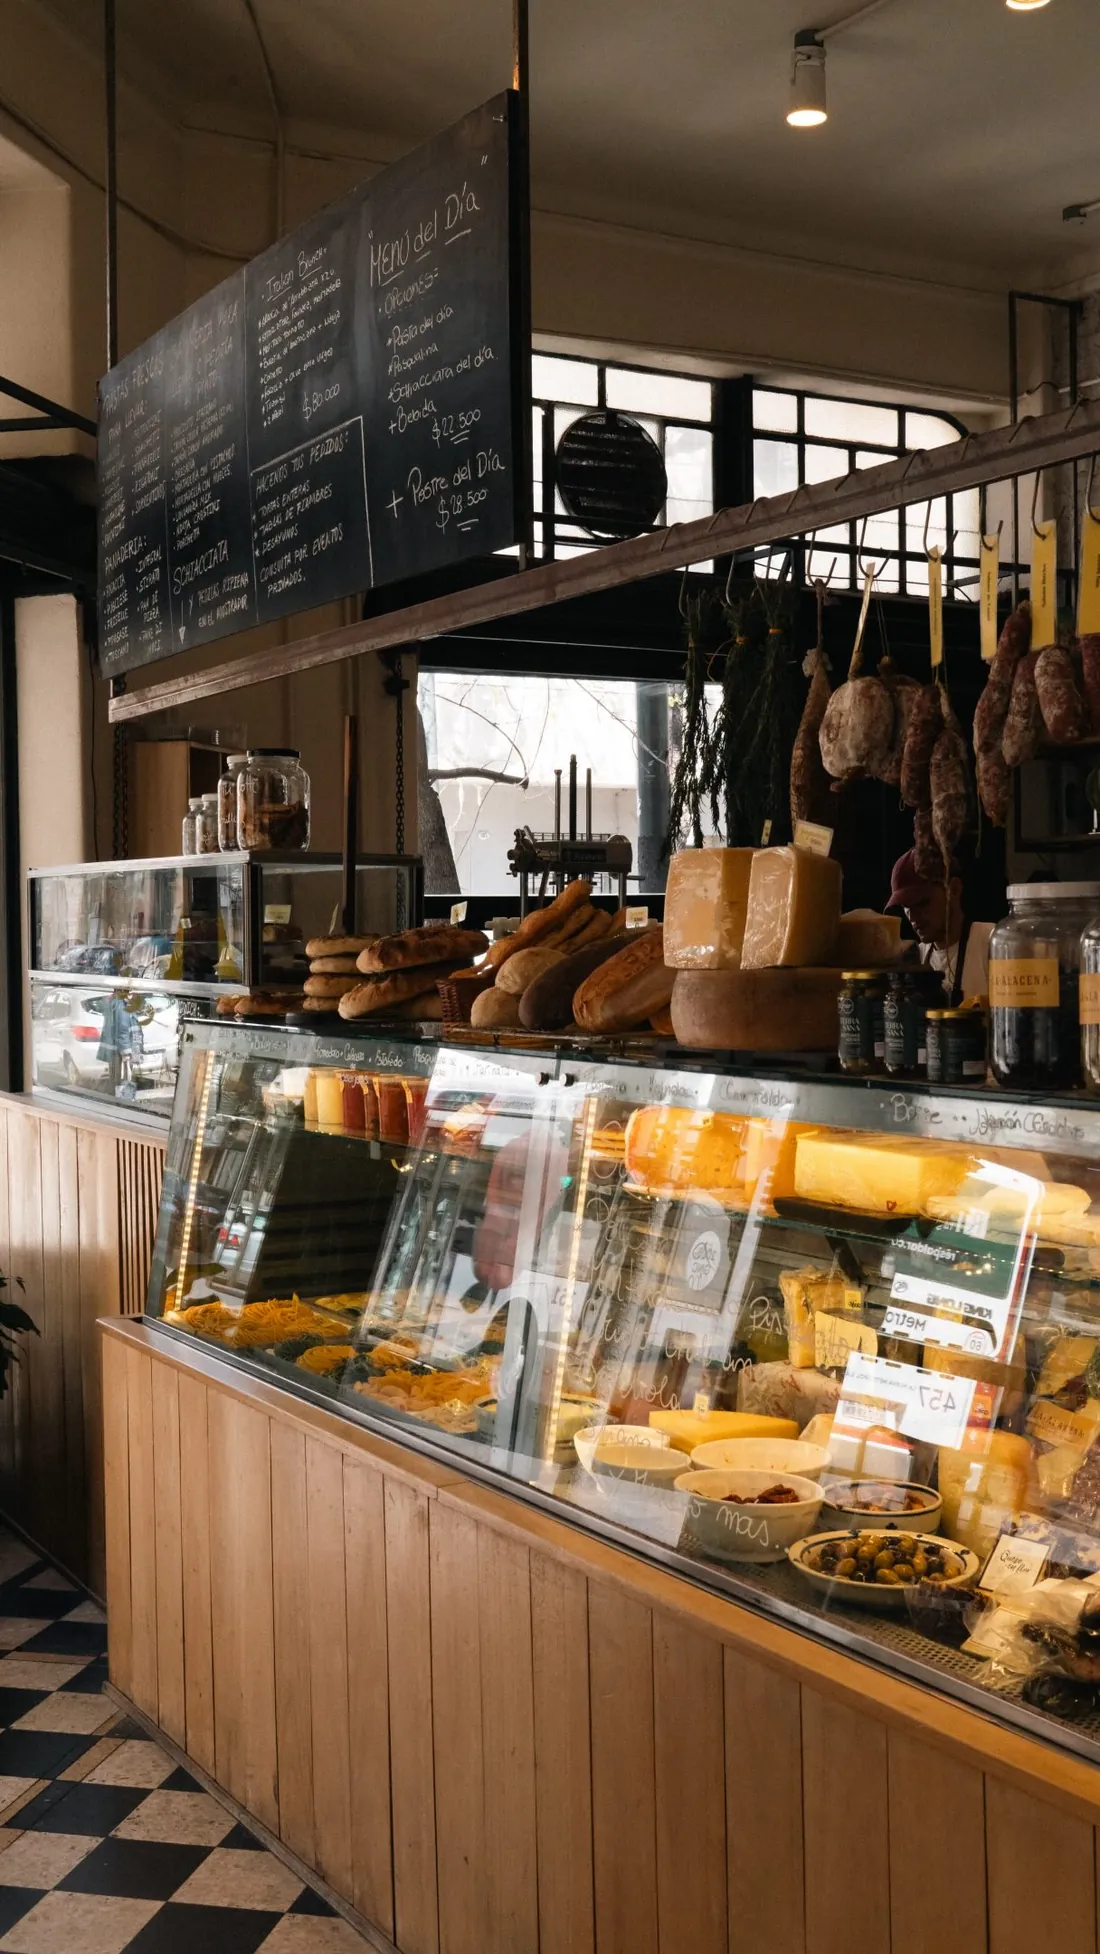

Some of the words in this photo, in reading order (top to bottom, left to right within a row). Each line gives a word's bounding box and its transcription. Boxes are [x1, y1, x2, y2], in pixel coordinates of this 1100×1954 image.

[413, 209, 437, 252] del
[444, 181, 480, 230] Día
[419, 317, 433, 334] del
[456, 353, 471, 374] del
[302, 384, 341, 422] $80.000
[432, 408, 482, 448] $22.500
[292, 453, 305, 473] TUS
[408, 466, 449, 506] Postre
[453, 459, 472, 486] del
[476, 448, 506, 478] Día
[436, 488, 488, 534] $28.500
[173, 539, 230, 596] SCHIACCIATA
